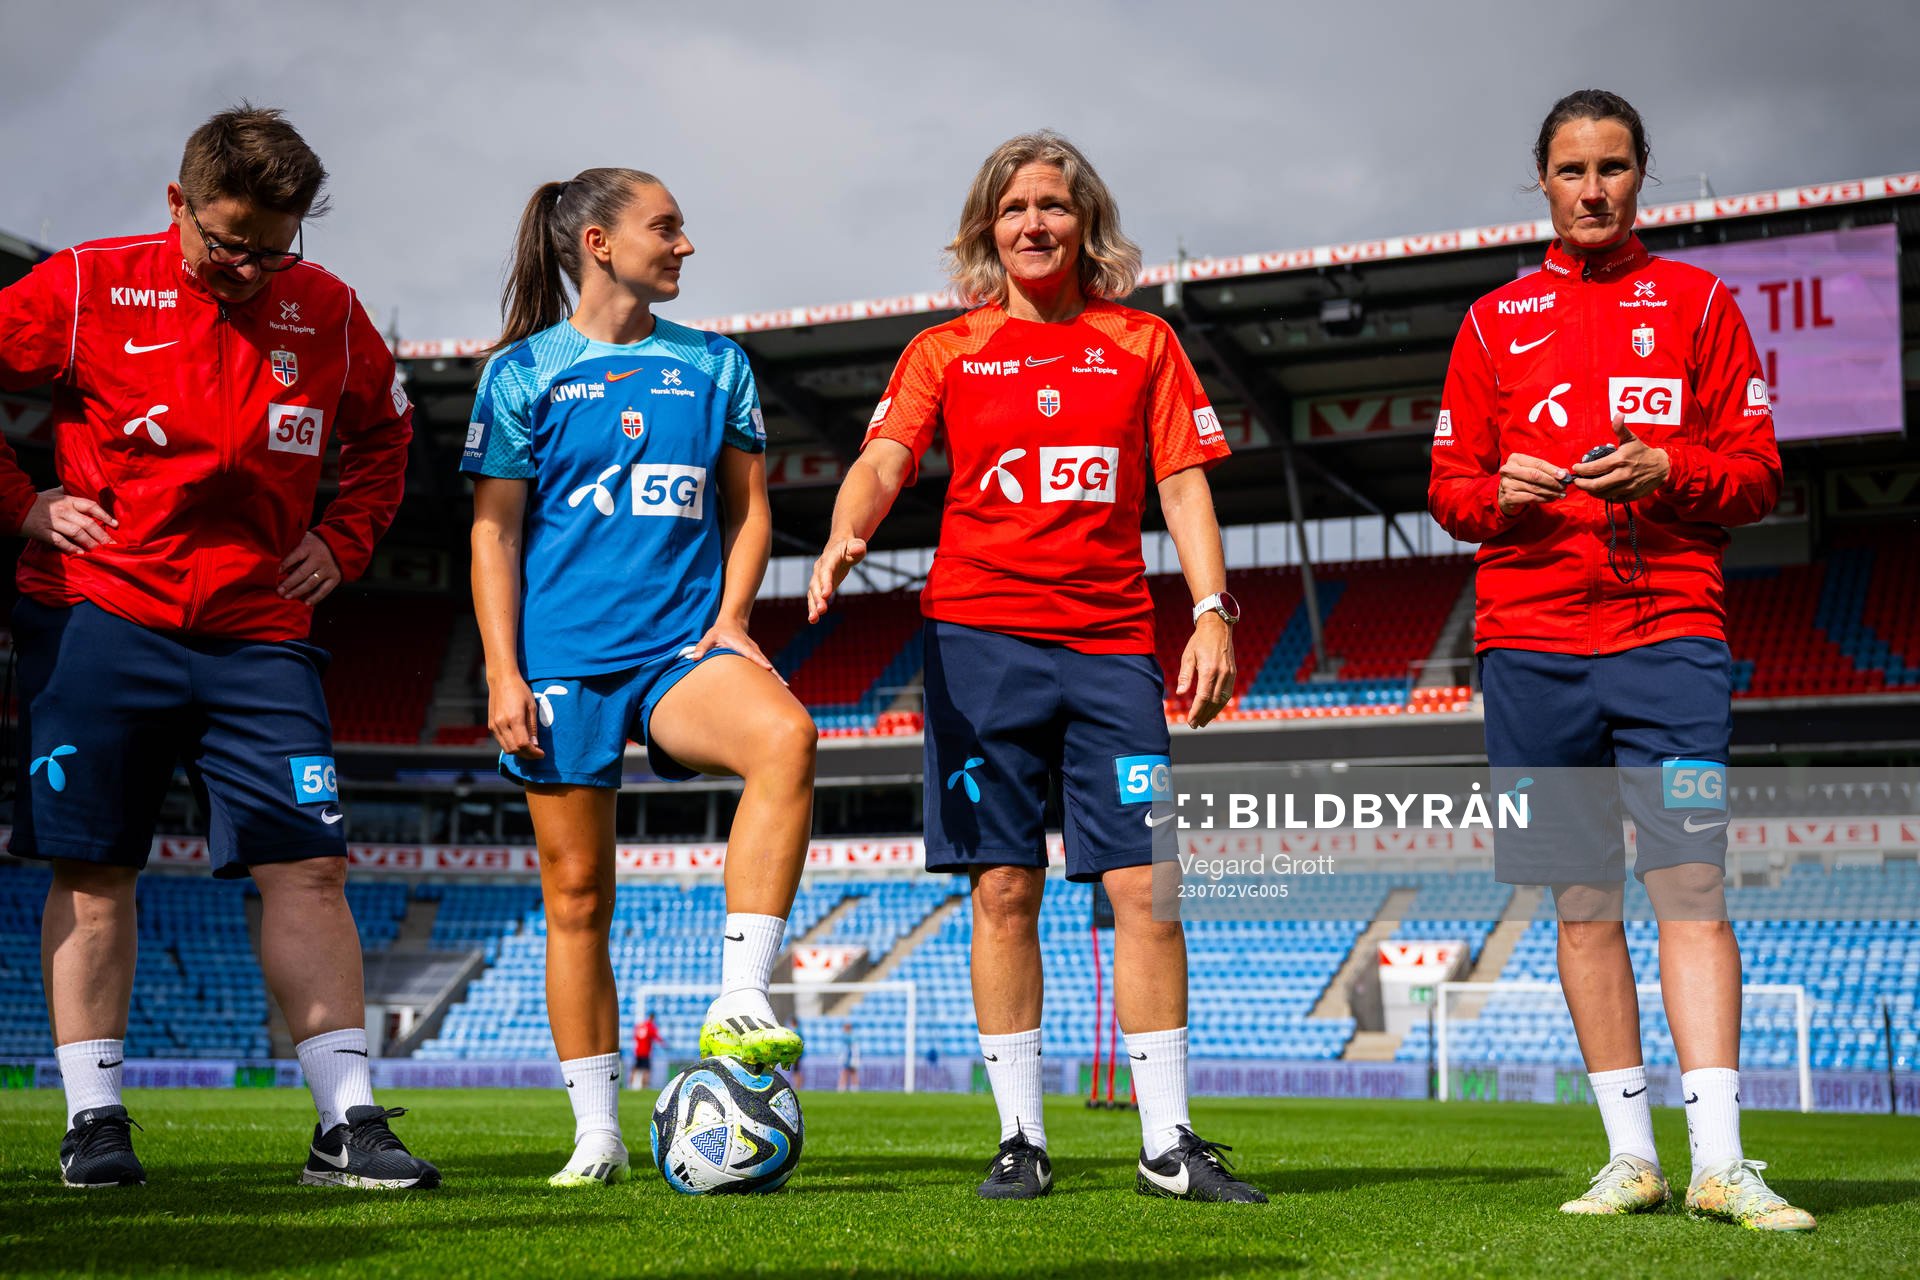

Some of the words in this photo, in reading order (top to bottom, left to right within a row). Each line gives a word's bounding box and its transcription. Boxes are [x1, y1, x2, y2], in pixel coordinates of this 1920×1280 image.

[1718, 194, 1774, 215] VG
[1801, 183, 1861, 204] VG
[1333, 241, 1384, 262] VG
[1405, 232, 1457, 253] VG
[1481, 224, 1533, 244] VG
[111, 287, 156, 307] KIWI
[158, 289, 178, 299] mini
[1539, 291, 1556, 304] mini
[159, 299, 177, 309] pris
[1498, 297, 1538, 314] KIWI
[1539, 301, 1554, 313] pris
[1620, 300, 1641, 308] Norsk
[1758, 276, 1834, 332] TIL
[269, 321, 288, 332] Norsk
[289, 324, 316, 335] Tipping
[962, 360, 1001, 376] KIWI
[1003, 360, 1020, 368] mini
[1003, 367, 1019, 376] pris
[1072, 366, 1092, 374] Norsk
[1092, 366, 1118, 376] Tipping
[550, 383, 588, 404] KIWI
[588, 382, 605, 391] mini
[650, 388, 670, 396] Norsk
[670, 388, 696, 398] Tipping
[588, 391, 605, 400] pris
[1616, 386, 1673, 416] 5G
[276, 414, 316, 446] 5G
[1050, 457, 1110, 491] 5G
[640, 474, 699, 508] 5G
[302, 765, 338, 794] 5G
[1126, 764, 1170, 794] 5G
[1671, 769, 1722, 800] 5G
